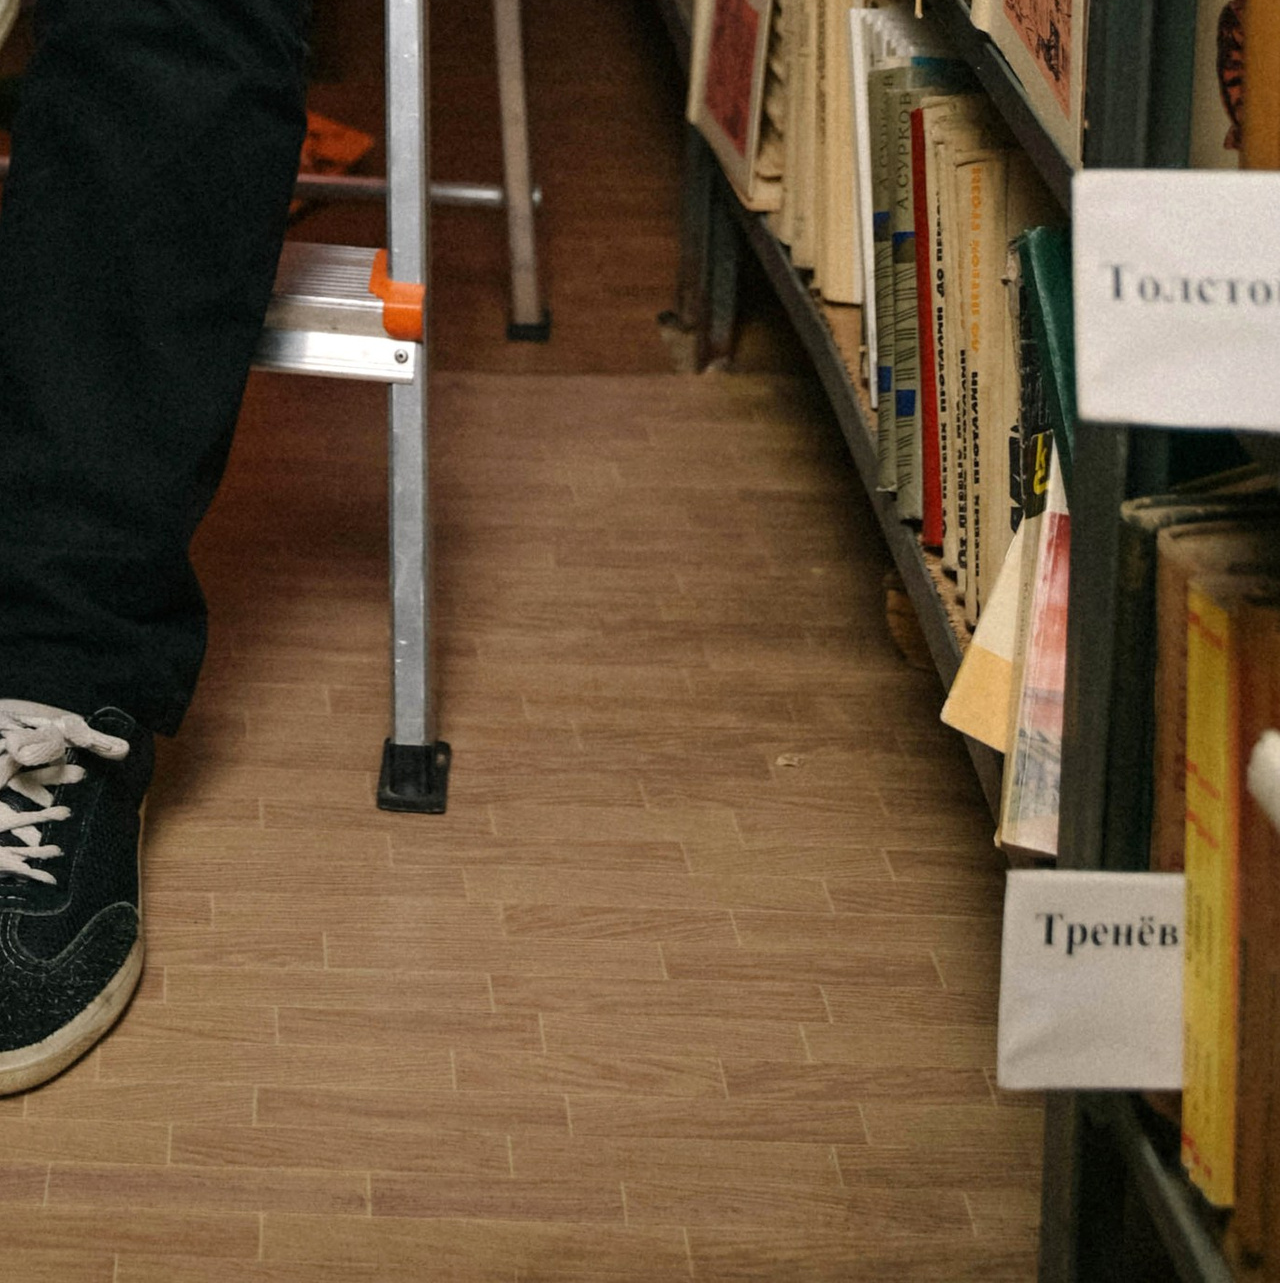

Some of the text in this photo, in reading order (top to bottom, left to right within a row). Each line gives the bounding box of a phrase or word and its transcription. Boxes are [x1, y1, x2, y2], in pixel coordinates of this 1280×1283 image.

[896, 92, 912, 211] А.СУРКОВ
[1099, 262, 1280, 306] Толсто
[1035, 913, 1179, 956] Тренёв
